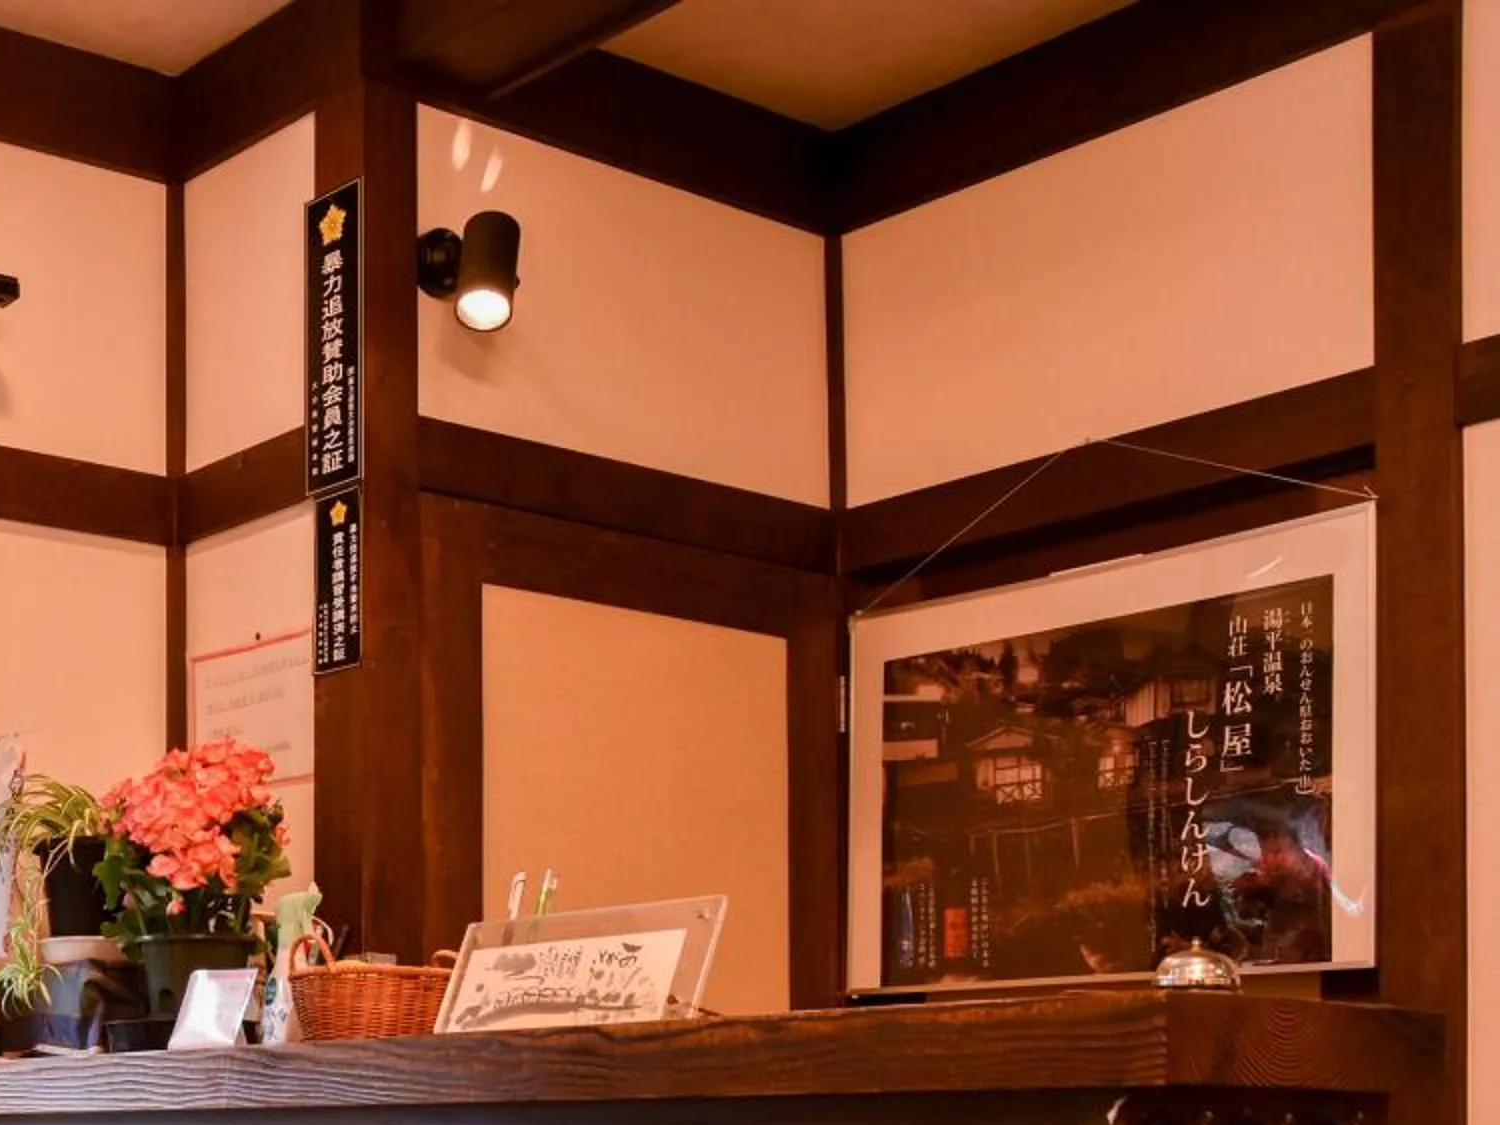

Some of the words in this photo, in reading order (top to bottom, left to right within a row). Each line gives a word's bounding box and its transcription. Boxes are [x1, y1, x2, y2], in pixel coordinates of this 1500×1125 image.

[321, 250, 344, 472] 暴力追放賛助会員之証
[1220, 614, 1254, 774] 山荘「松屋」
[1261, 607, 1284, 695] 湯平温泉
[1180, 711, 1210, 908] しらしんけん
